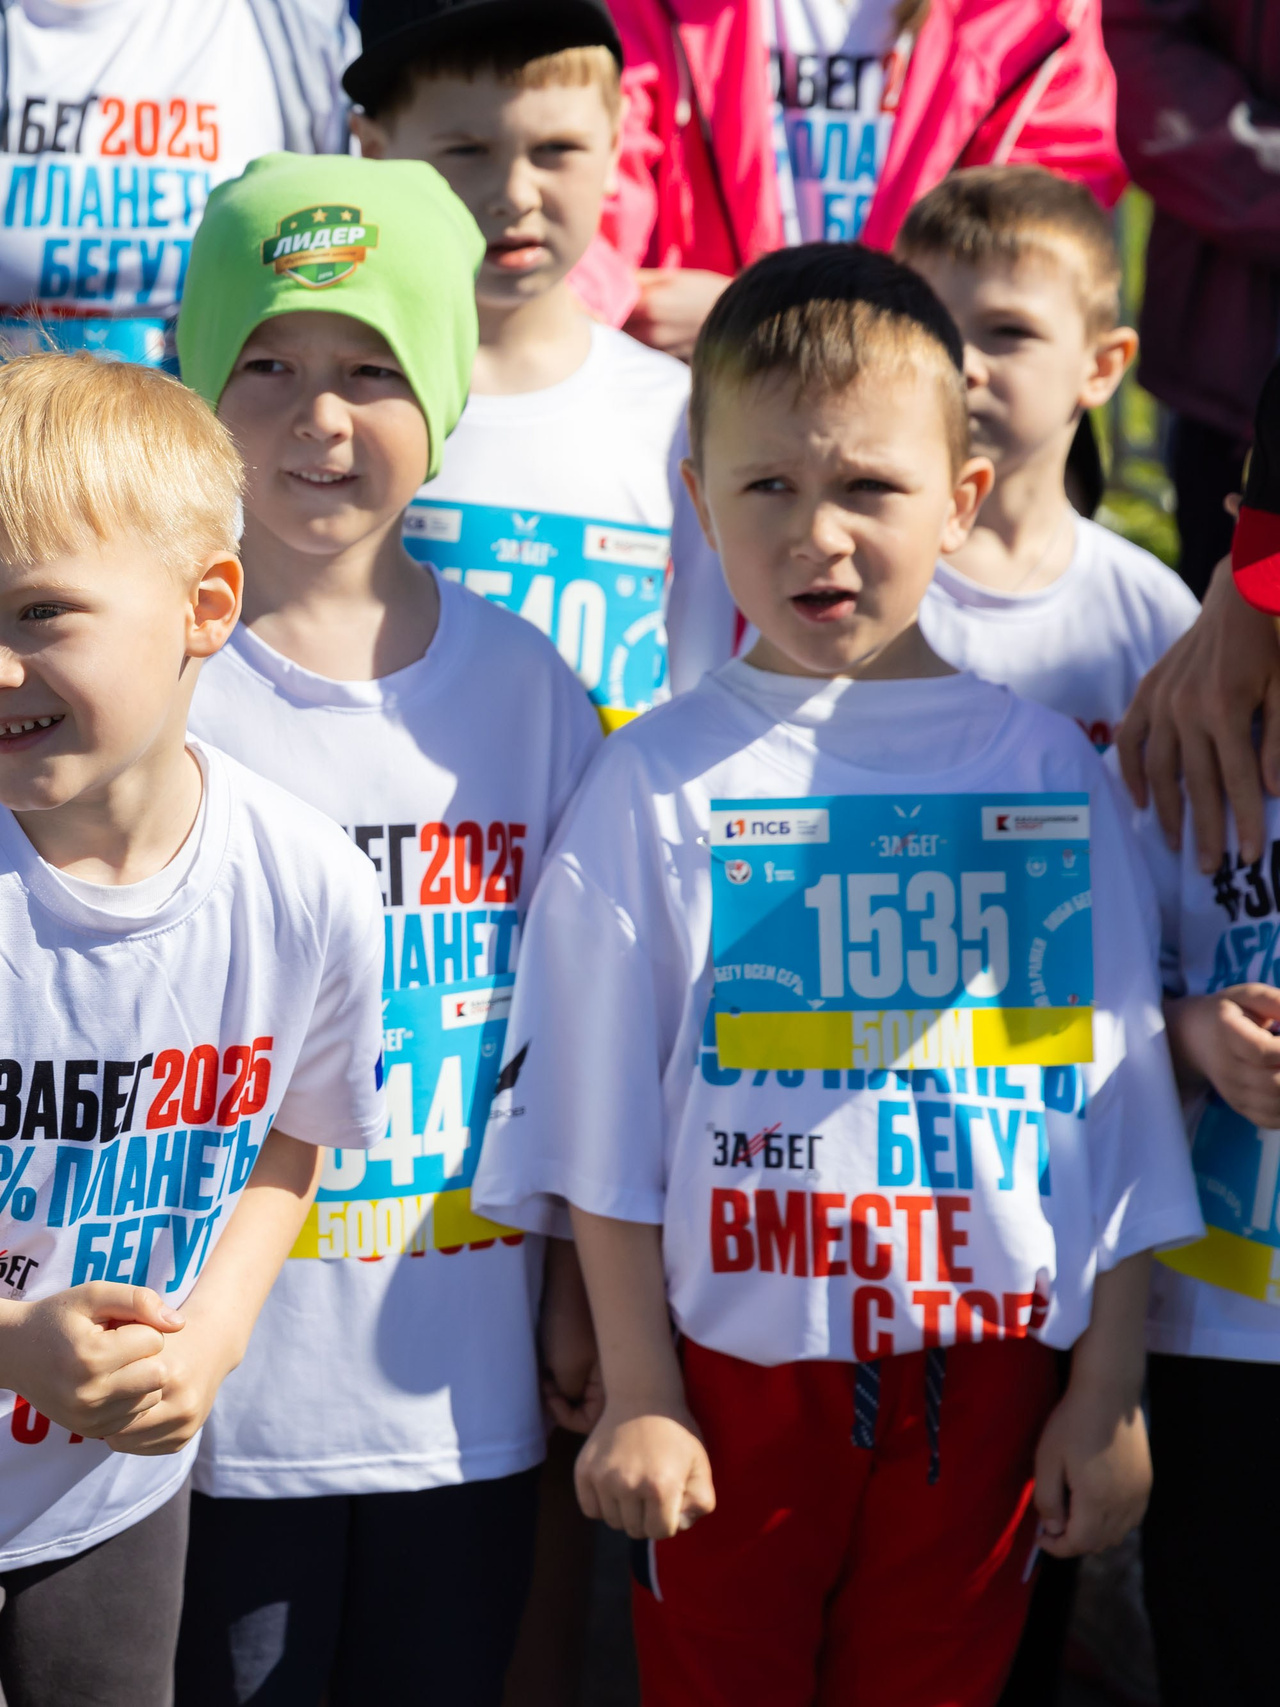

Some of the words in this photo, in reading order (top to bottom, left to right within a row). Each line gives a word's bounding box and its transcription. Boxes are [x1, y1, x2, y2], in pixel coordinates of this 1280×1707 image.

[4, 162, 211, 228] ПЛАНЕТ
[273, 226, 366, 259] ЛИДЕР
[751, 820, 792, 836] ПСБ
[341, 820, 527, 908] ЕГ2025
[805, 870, 1010, 999] 1535
[851, 1009, 974, 1068] 500М
[877, 1100, 1052, 1195] БЕГУТ
[318, 1194, 435, 1259] 500М
[709, 1187, 974, 1284] ВМЕСТЕ
[852, 1285, 894, 1362] С
